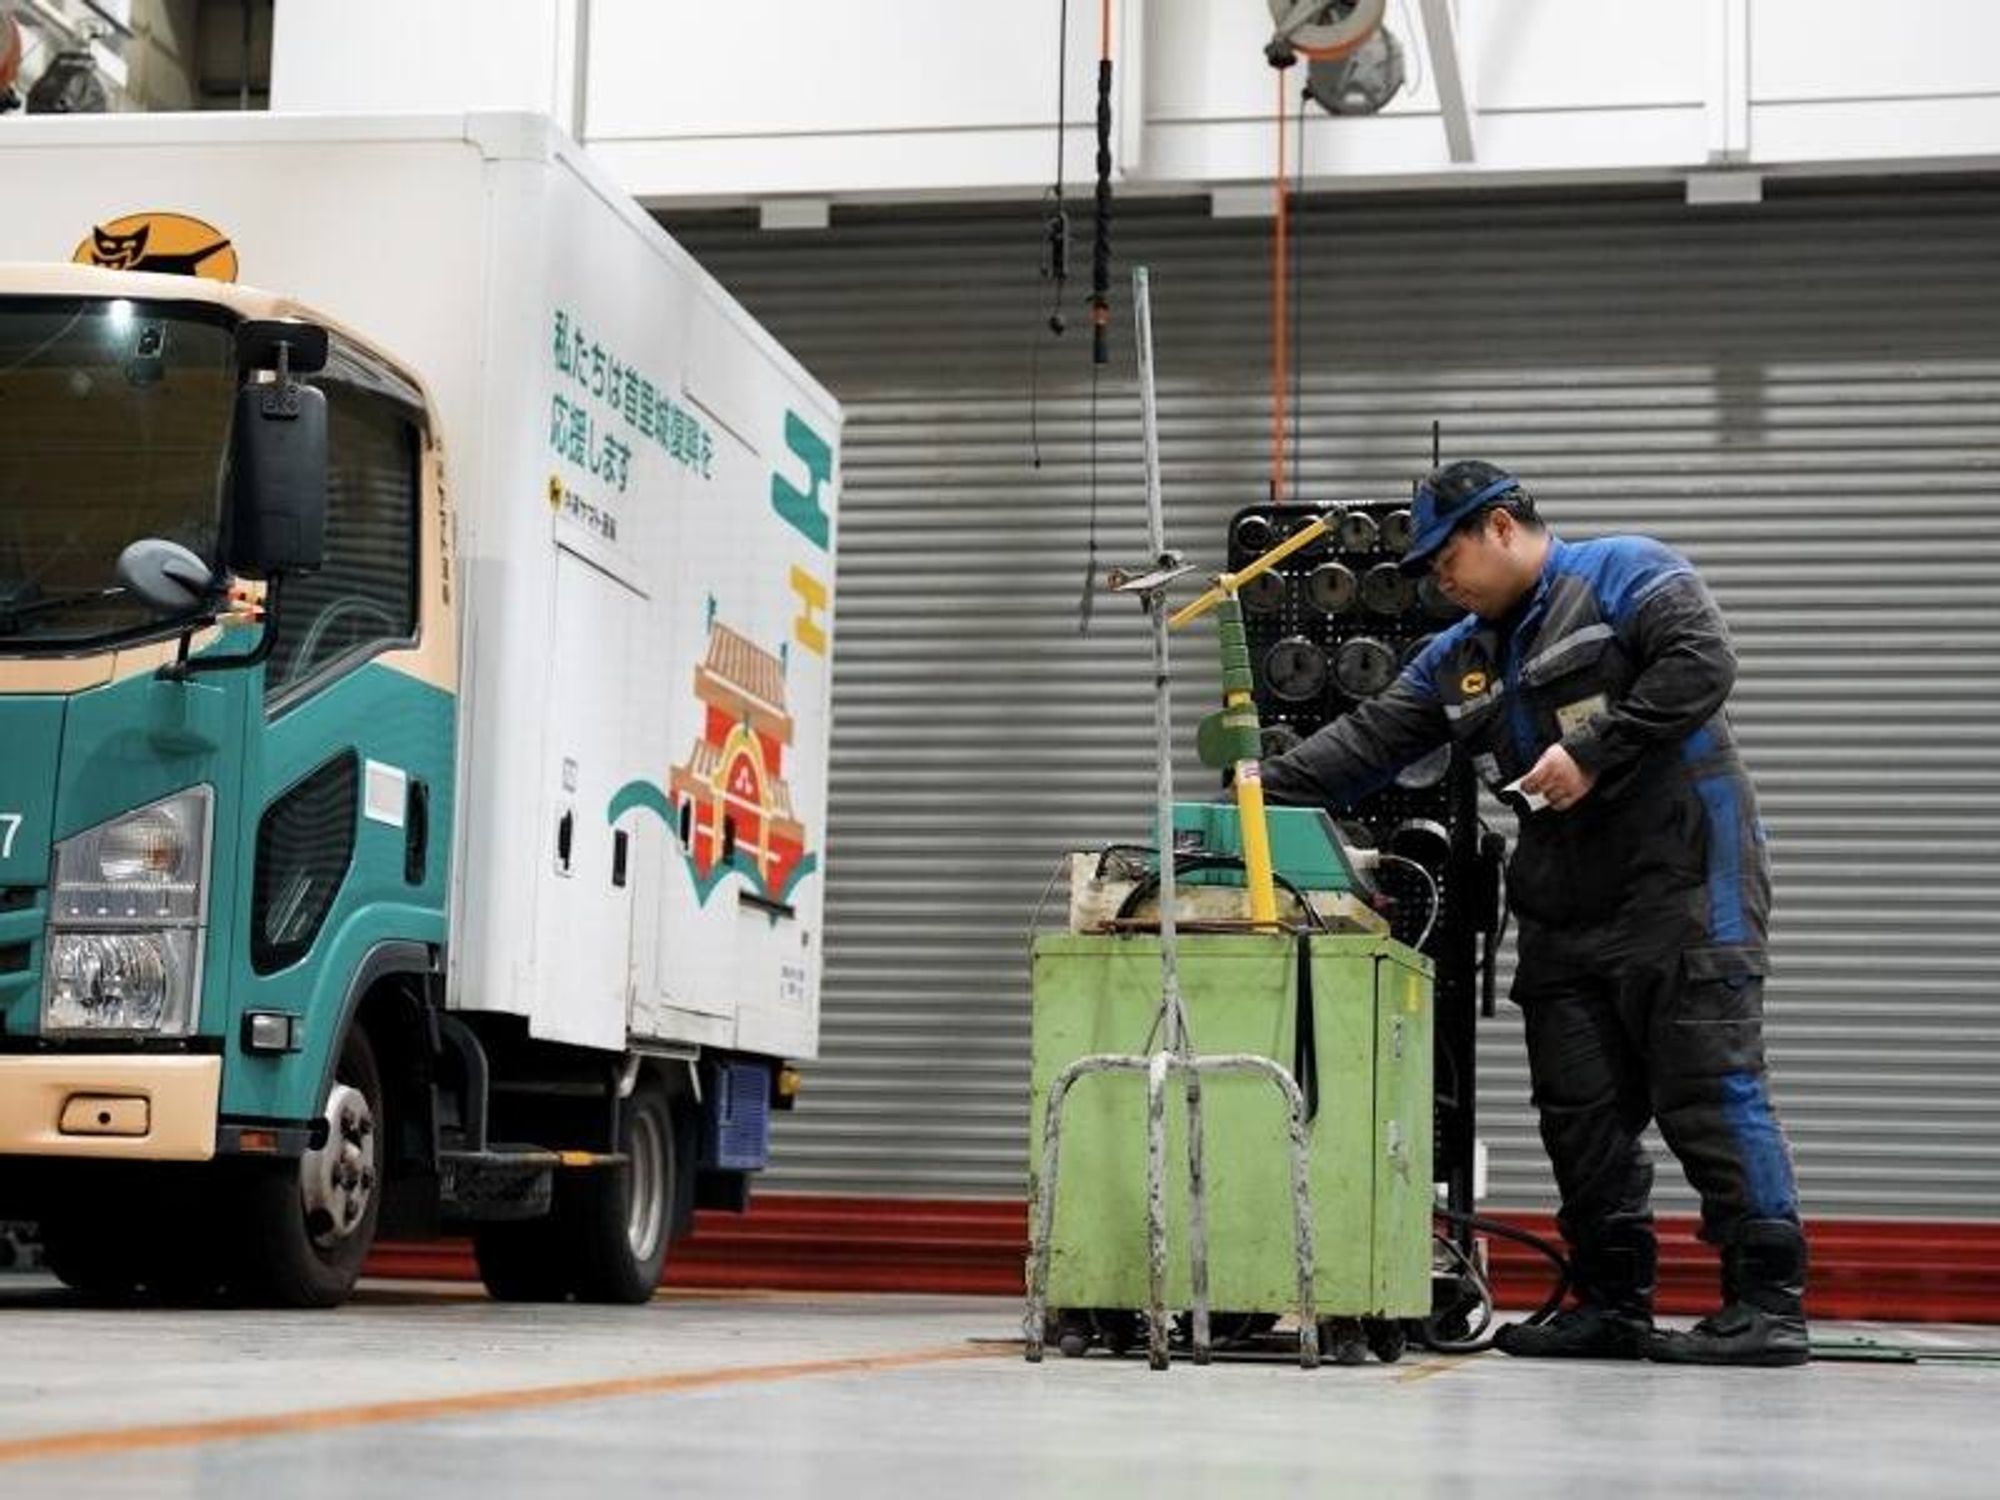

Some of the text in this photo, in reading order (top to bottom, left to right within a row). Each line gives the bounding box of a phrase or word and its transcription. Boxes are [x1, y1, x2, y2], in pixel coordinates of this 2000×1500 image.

[551, 393, 632, 492] 応援します
[0, 813, 22, 858] 7
